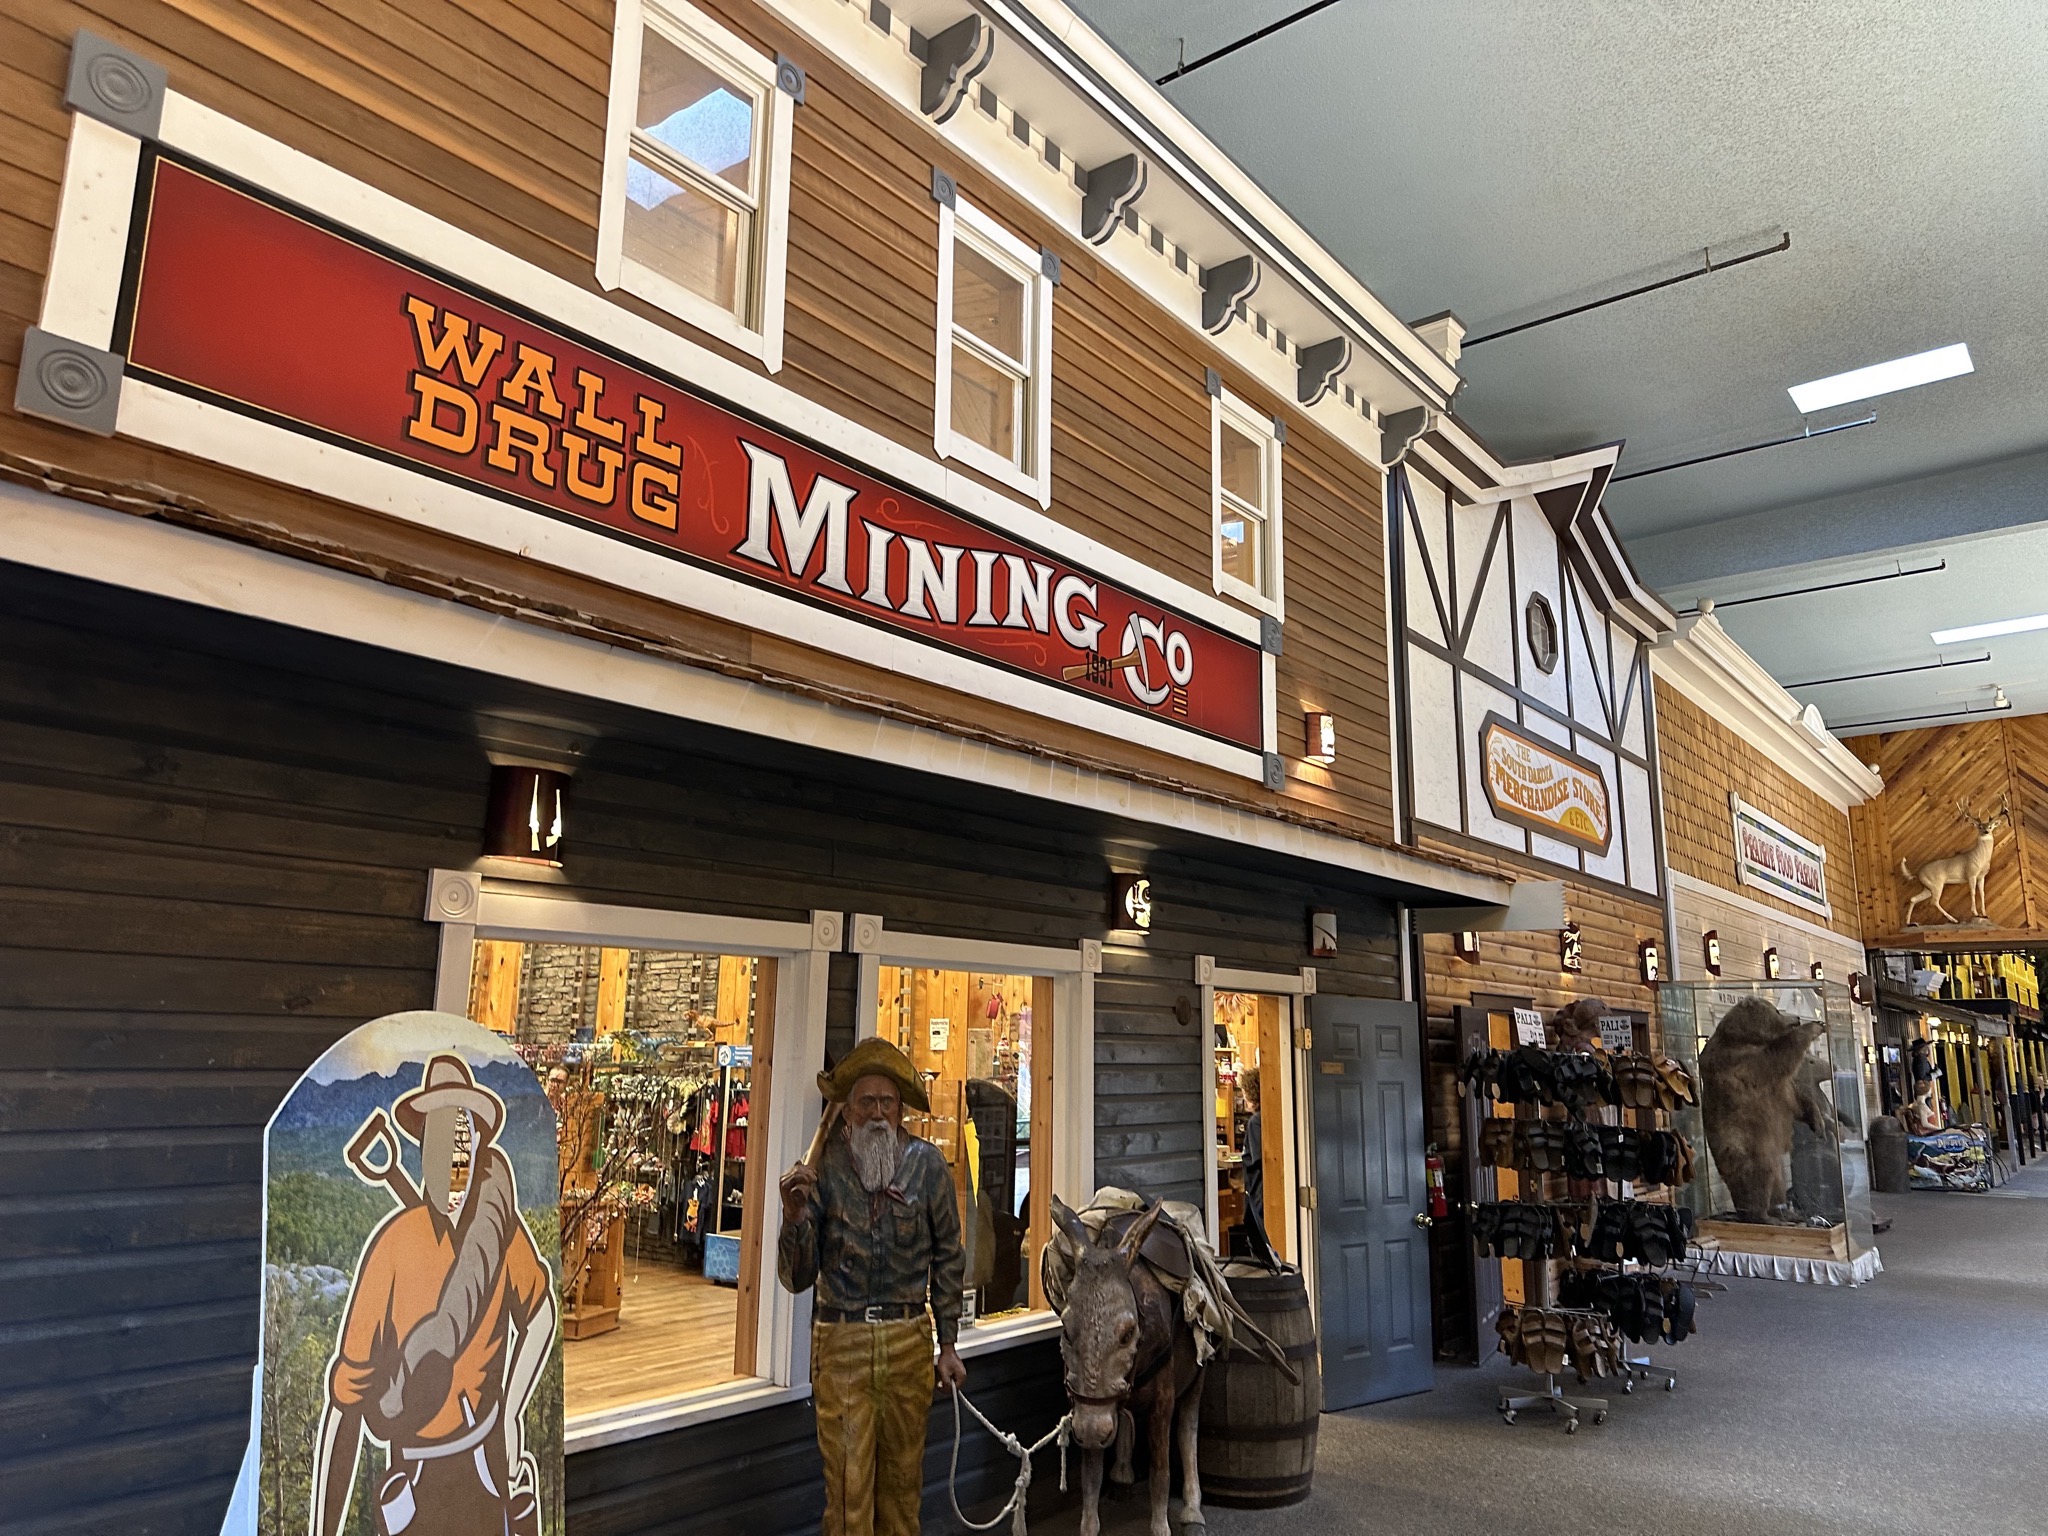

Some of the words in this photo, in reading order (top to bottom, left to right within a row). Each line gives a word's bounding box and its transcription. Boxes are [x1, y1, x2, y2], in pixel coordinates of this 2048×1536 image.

[406, 294, 683, 469] WALL
[407, 371, 681, 532] DRUG
[734, 438, 1105, 651] MINING
[1085, 651, 1114, 689] 1931
[1502, 747, 1527, 781] SOUTH
[1528, 764, 1554, 784] DAKOTA
[1516, 743, 1532, 763] THE
[1494, 758, 1570, 812] MERCHANDISE
[1572, 777, 1603, 828] STORE
[1775, 845, 1793, 880] FOOD
[1794, 855, 1820, 893] PARLOR
[1516, 1012, 1533, 1026] PALI
[1600, 1020, 1620, 1031] PALI
